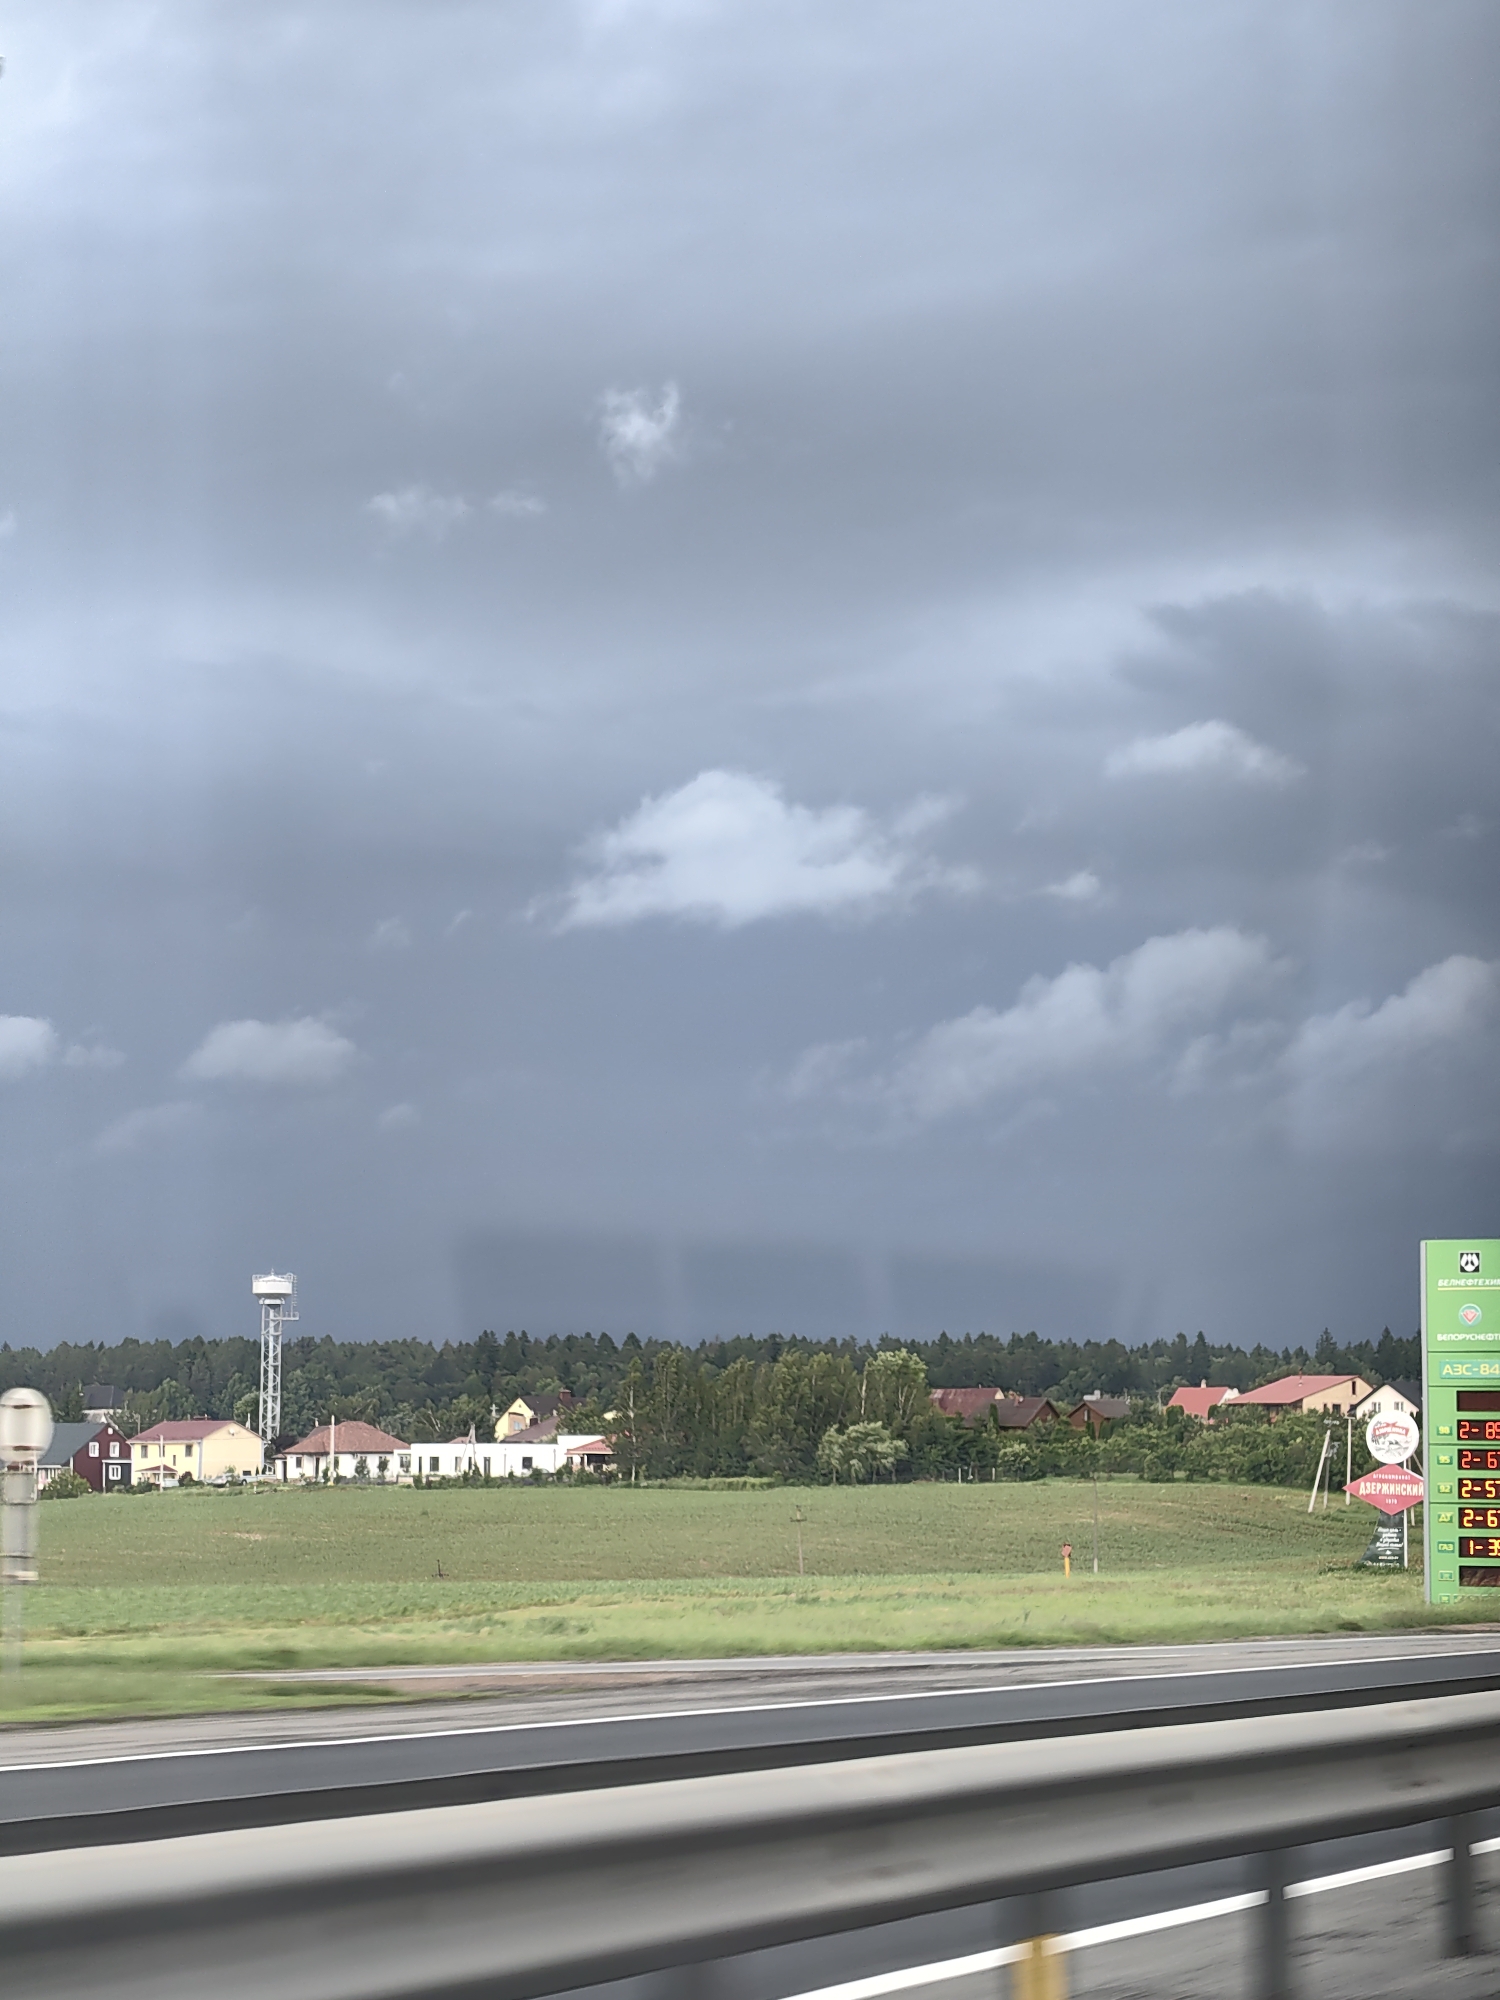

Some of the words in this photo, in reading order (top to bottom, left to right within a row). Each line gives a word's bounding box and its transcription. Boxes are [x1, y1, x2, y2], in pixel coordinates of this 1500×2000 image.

[1437, 1333, 1500, 1341] БЕЛОРУСНЕФТ
[1359, 1481, 1424, 1497] ДЗЕРЖИНСКИЙ
[1438, 1543, 1454, 1551] ГАЗ
